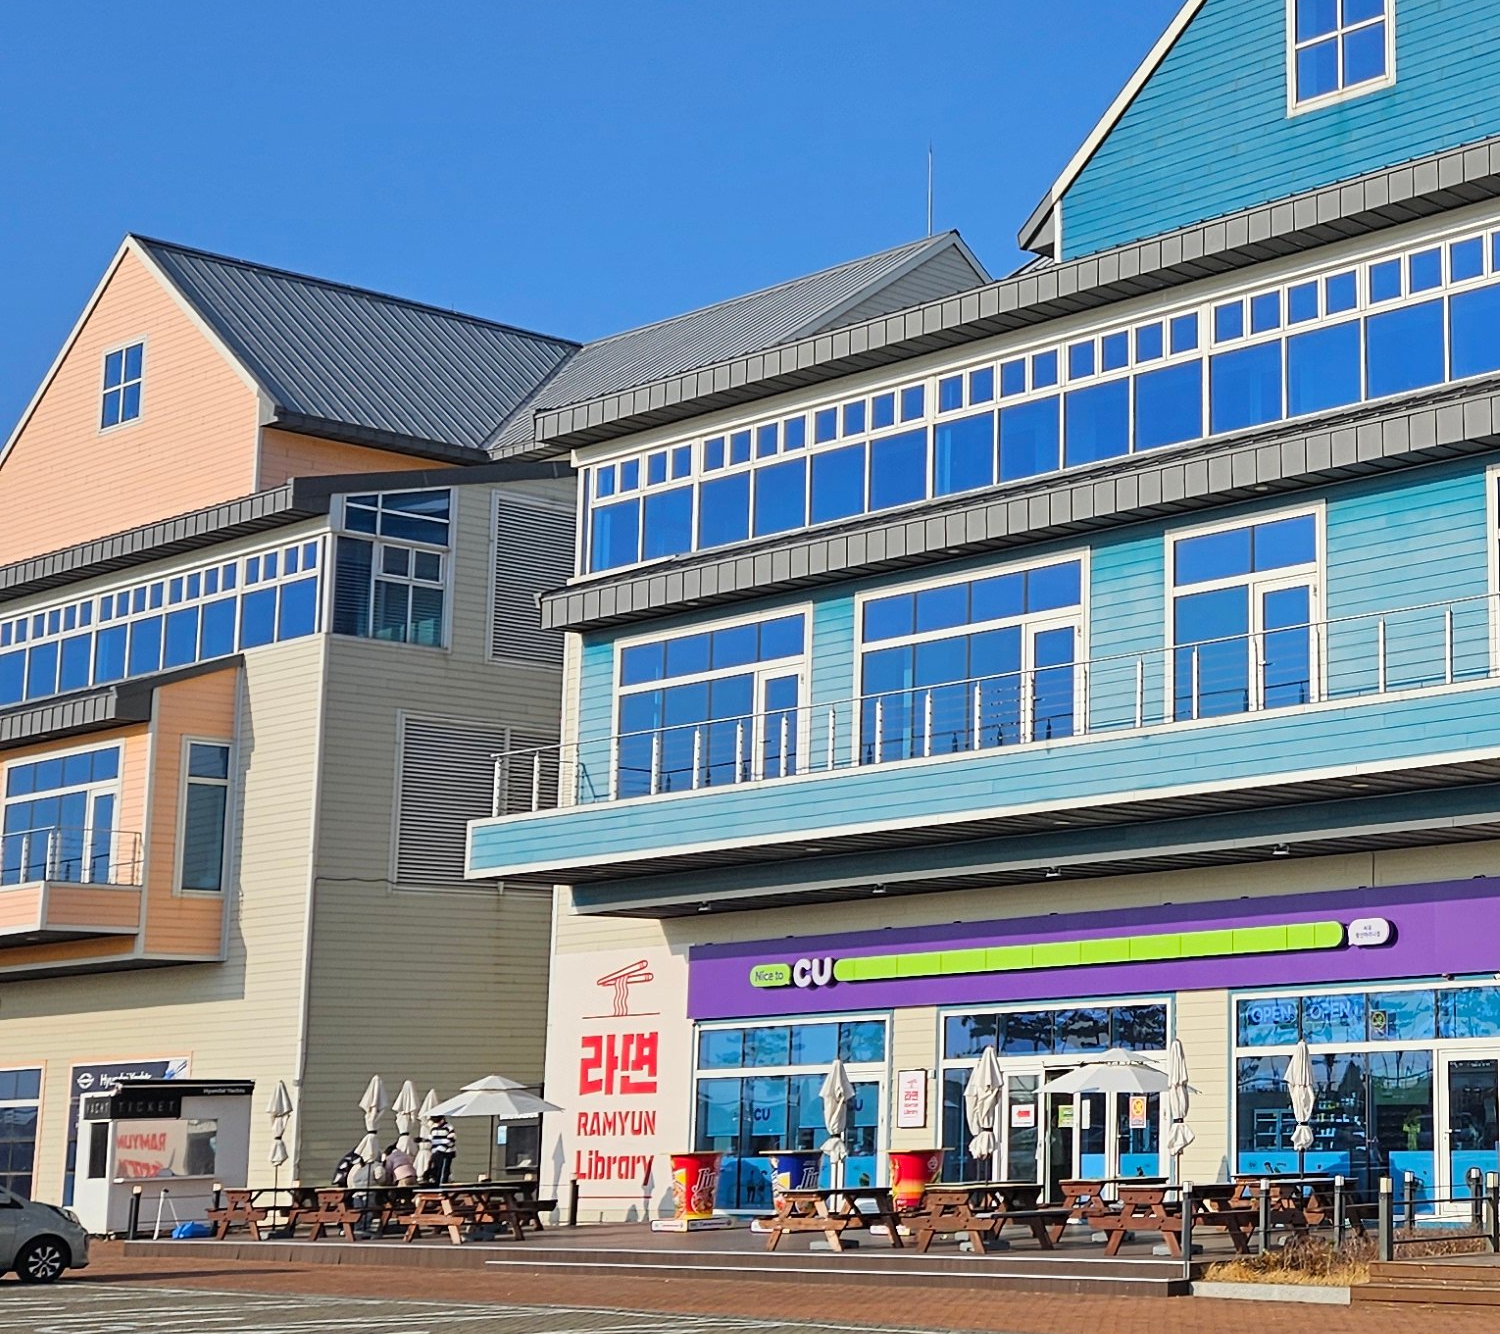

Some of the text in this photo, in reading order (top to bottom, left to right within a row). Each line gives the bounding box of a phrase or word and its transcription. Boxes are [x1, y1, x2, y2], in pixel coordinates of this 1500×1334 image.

[755, 956, 832, 987] Nice to CU
[1251, 1004, 1292, 1023] OPEN
[579, 1032, 658, 1095] 라면
[119, 1100, 175, 1113] TICKET
[754, 1108, 771, 1121] CU
[577, 1110, 657, 1136] RAMYUN
[575, 1150, 654, 1186] Library
